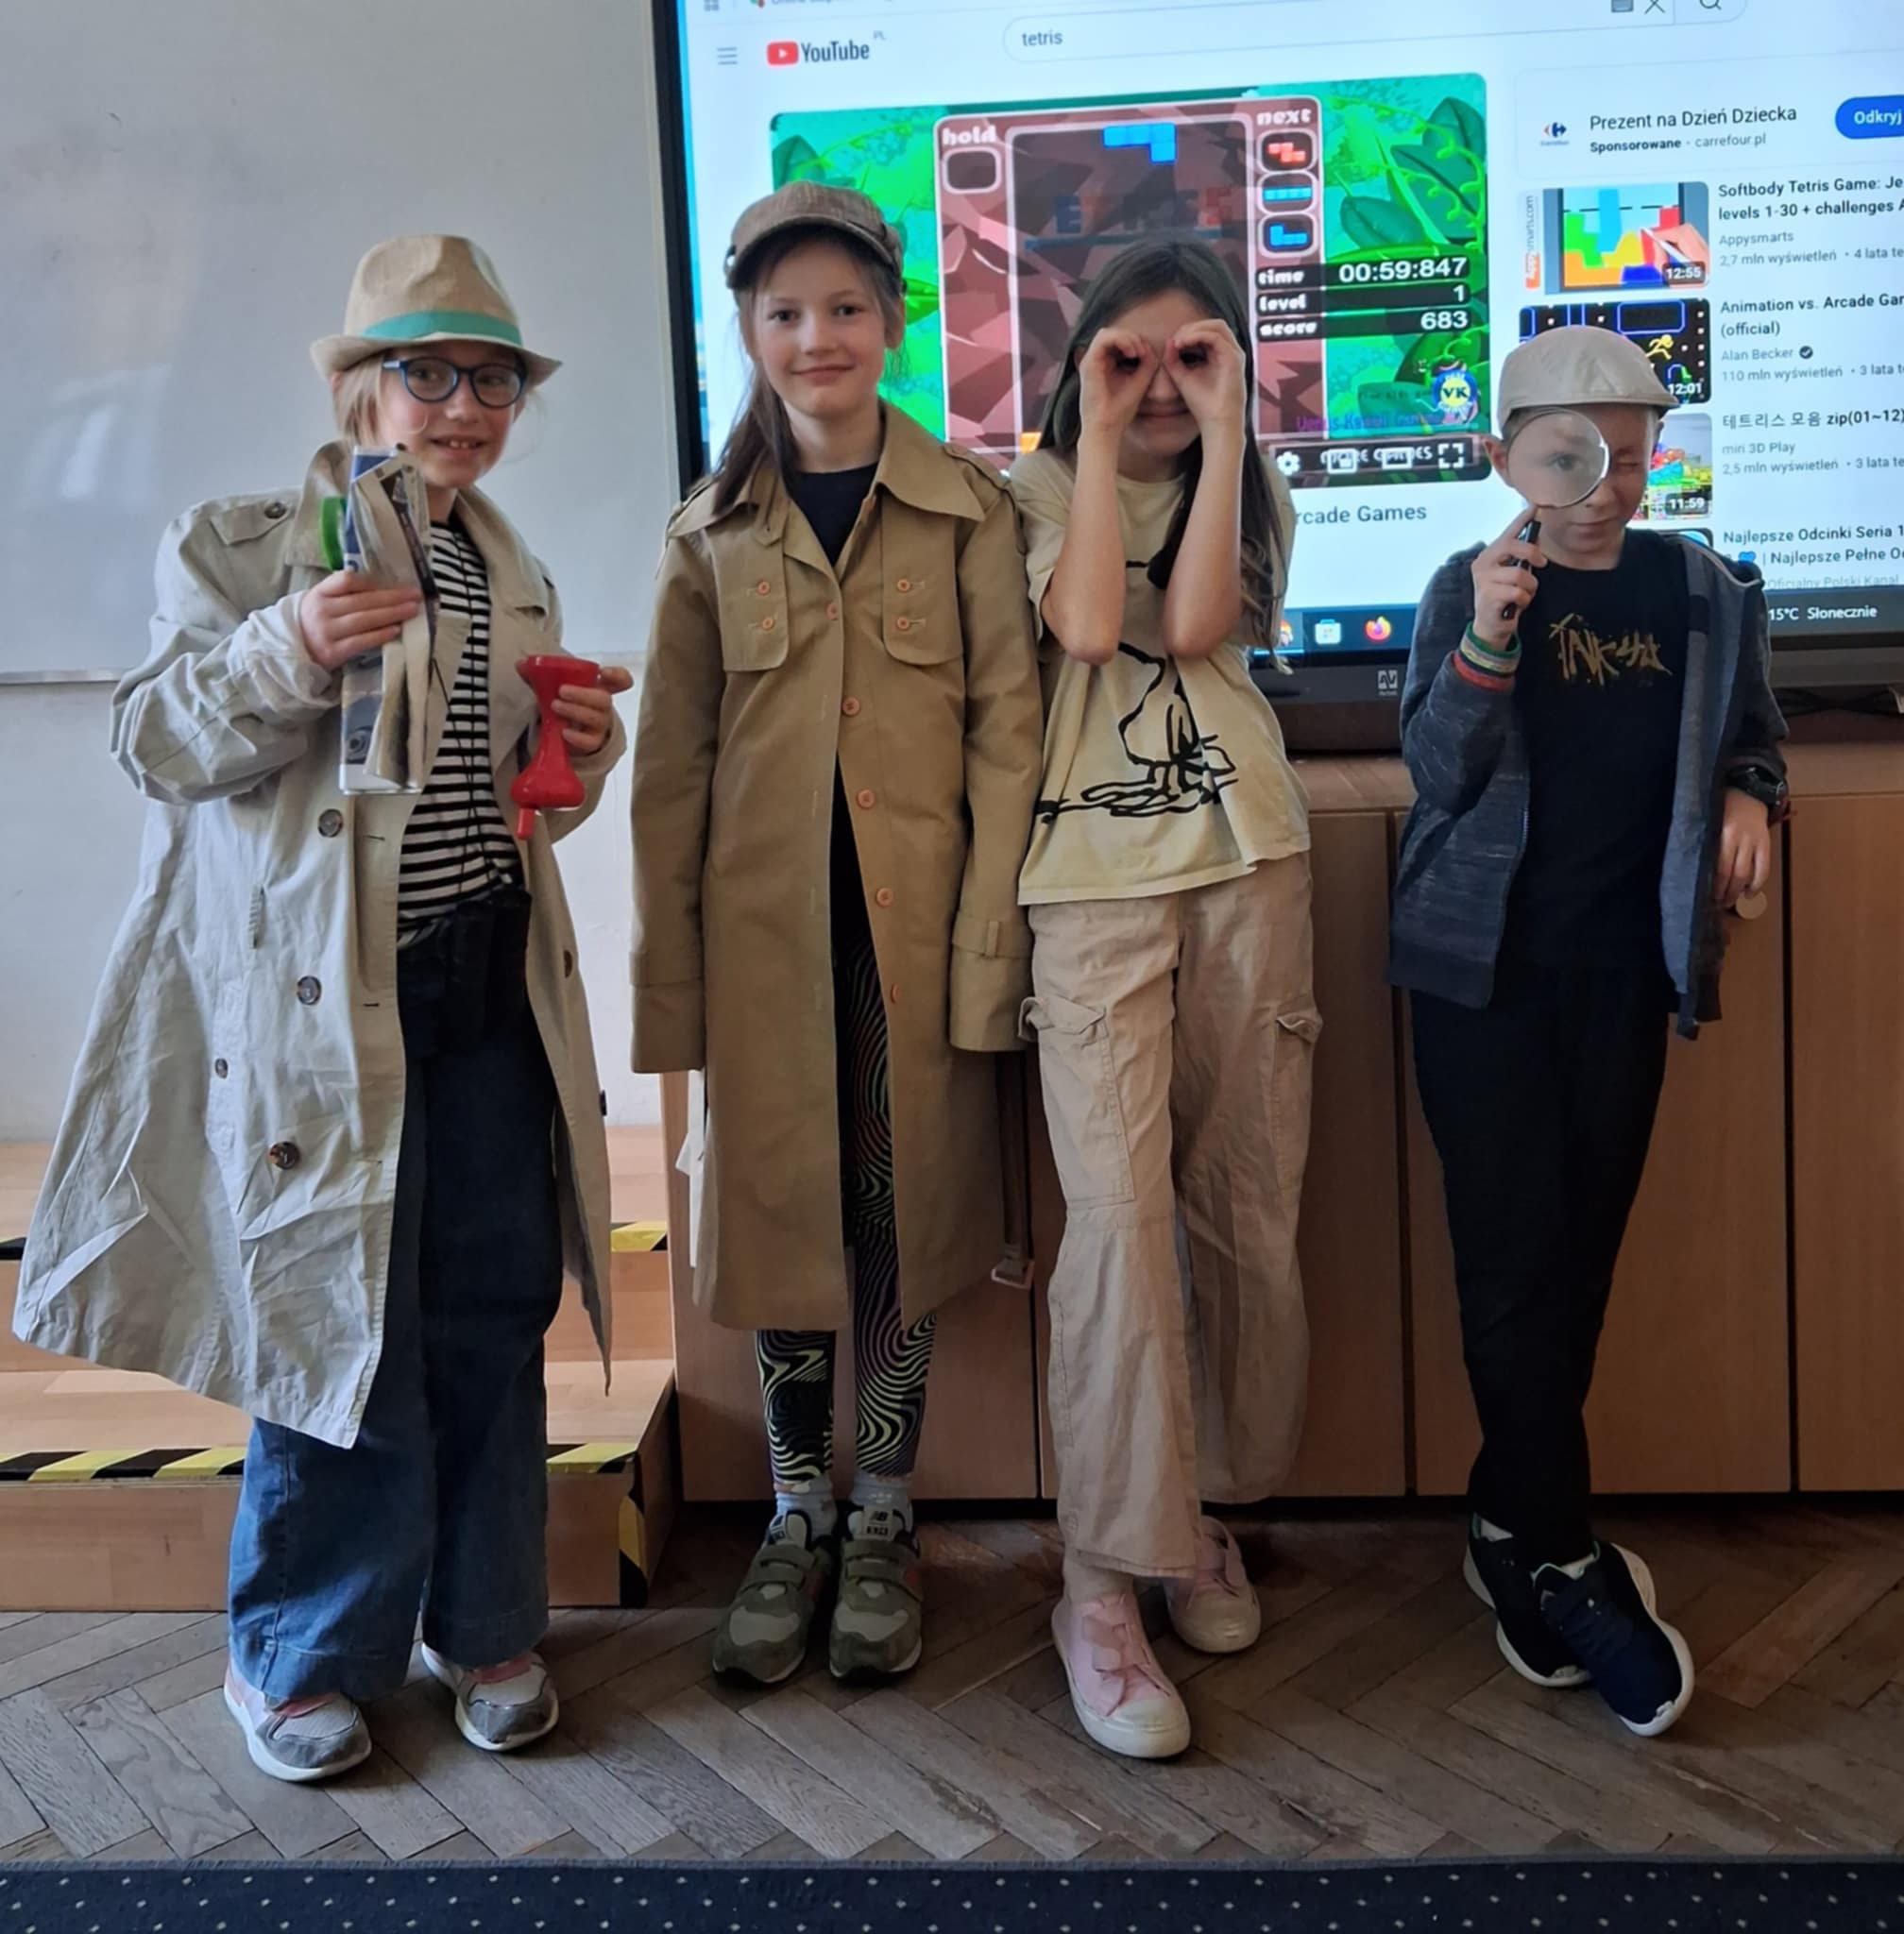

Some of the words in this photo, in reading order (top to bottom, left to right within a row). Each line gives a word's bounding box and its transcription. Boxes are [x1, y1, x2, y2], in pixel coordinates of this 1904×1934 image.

[1022, 30, 1063, 46] tetris
[801, 40, 870, 62] YouTube
[1257, 108, 1312, 126] next
[1590, 113, 1652, 130] Prezent
[1657, 114, 1677, 127] na
[1682, 107, 1727, 126] Dzień
[1732, 106, 1797, 124] Dziecka
[1853, 109, 1903, 126] Odkryj
[942, 126, 996, 145] hold
[1590, 139, 1682, 154] Sponsorowane
[1695, 133, 1766, 148] carrefour.pl
[1718, 181, 1784, 196] Softbody
[1788, 179, 1829, 194] Tetris
[1834, 178, 1880, 191] Game:
[1718, 206, 1760, 220] levels
[1765, 204, 1798, 217] 1-30
[1802, 207, 1811, 215] +
[1815, 200, 1894, 216] challenges
[1719, 231, 1794, 247] Appysmarts
[1720, 254, 1738, 267] 2,7
[1741, 252, 1764, 264] mln
[1767, 249, 1837, 265] wyświetleń
[1854, 248, 1862, 259] 4
[1864, 247, 1888, 259] lata
[1257, 269, 1304, 284] time
[1338, 257, 1467, 282] 00:59:847
[1666, 266, 1701, 280] 12:55
[1259, 294, 1307, 312] level
[1454, 285, 1465, 301] 1
[1720, 298, 1794, 314] Animation
[1823, 294, 1875, 309] Arcade
[1259, 321, 1318, 336] score
[1420, 311, 1469, 330] 683
[1721, 321, 1780, 338] (official)
[1721, 349, 1748, 362] Alan
[1752, 348, 1794, 361] Becker
[1722, 369, 1744, 382] 110
[1747, 368, 1771, 380] mln
[1774, 365, 1843, 382] wyświetleń
[1860, 365, 1867, 375] 3
[1871, 364, 1895, 375] lata
[1443, 386, 1468, 399] VK
[1667, 382, 1702, 395] 12:01
[1723, 413, 1786, 430] 테트리스
[1749, 443, 1765, 454] 3D
[1769, 441, 1795, 455] Play
[1723, 463, 1741, 475] 2,5
[1743, 462, 1767, 473] mln
[1771, 459, 1839, 475] wyświetleń
[1856, 458, 1863, 469] 3
[1866, 457, 1890, 468] lata
[1670, 497, 1705, 509] 11:59
[1296, 506, 1351, 524] rcade
[1356, 505, 1427, 522] Games
[1724, 529, 1794, 546] Najlepsze
[1798, 526, 1851, 541] Odcinki
[1856, 525, 1892, 538] Seria
[1770, 551, 1841, 567] Najlepsze
[1845, 548, 1886, 561] Pełne
[1768, 607, 1799, 621] 15°C
